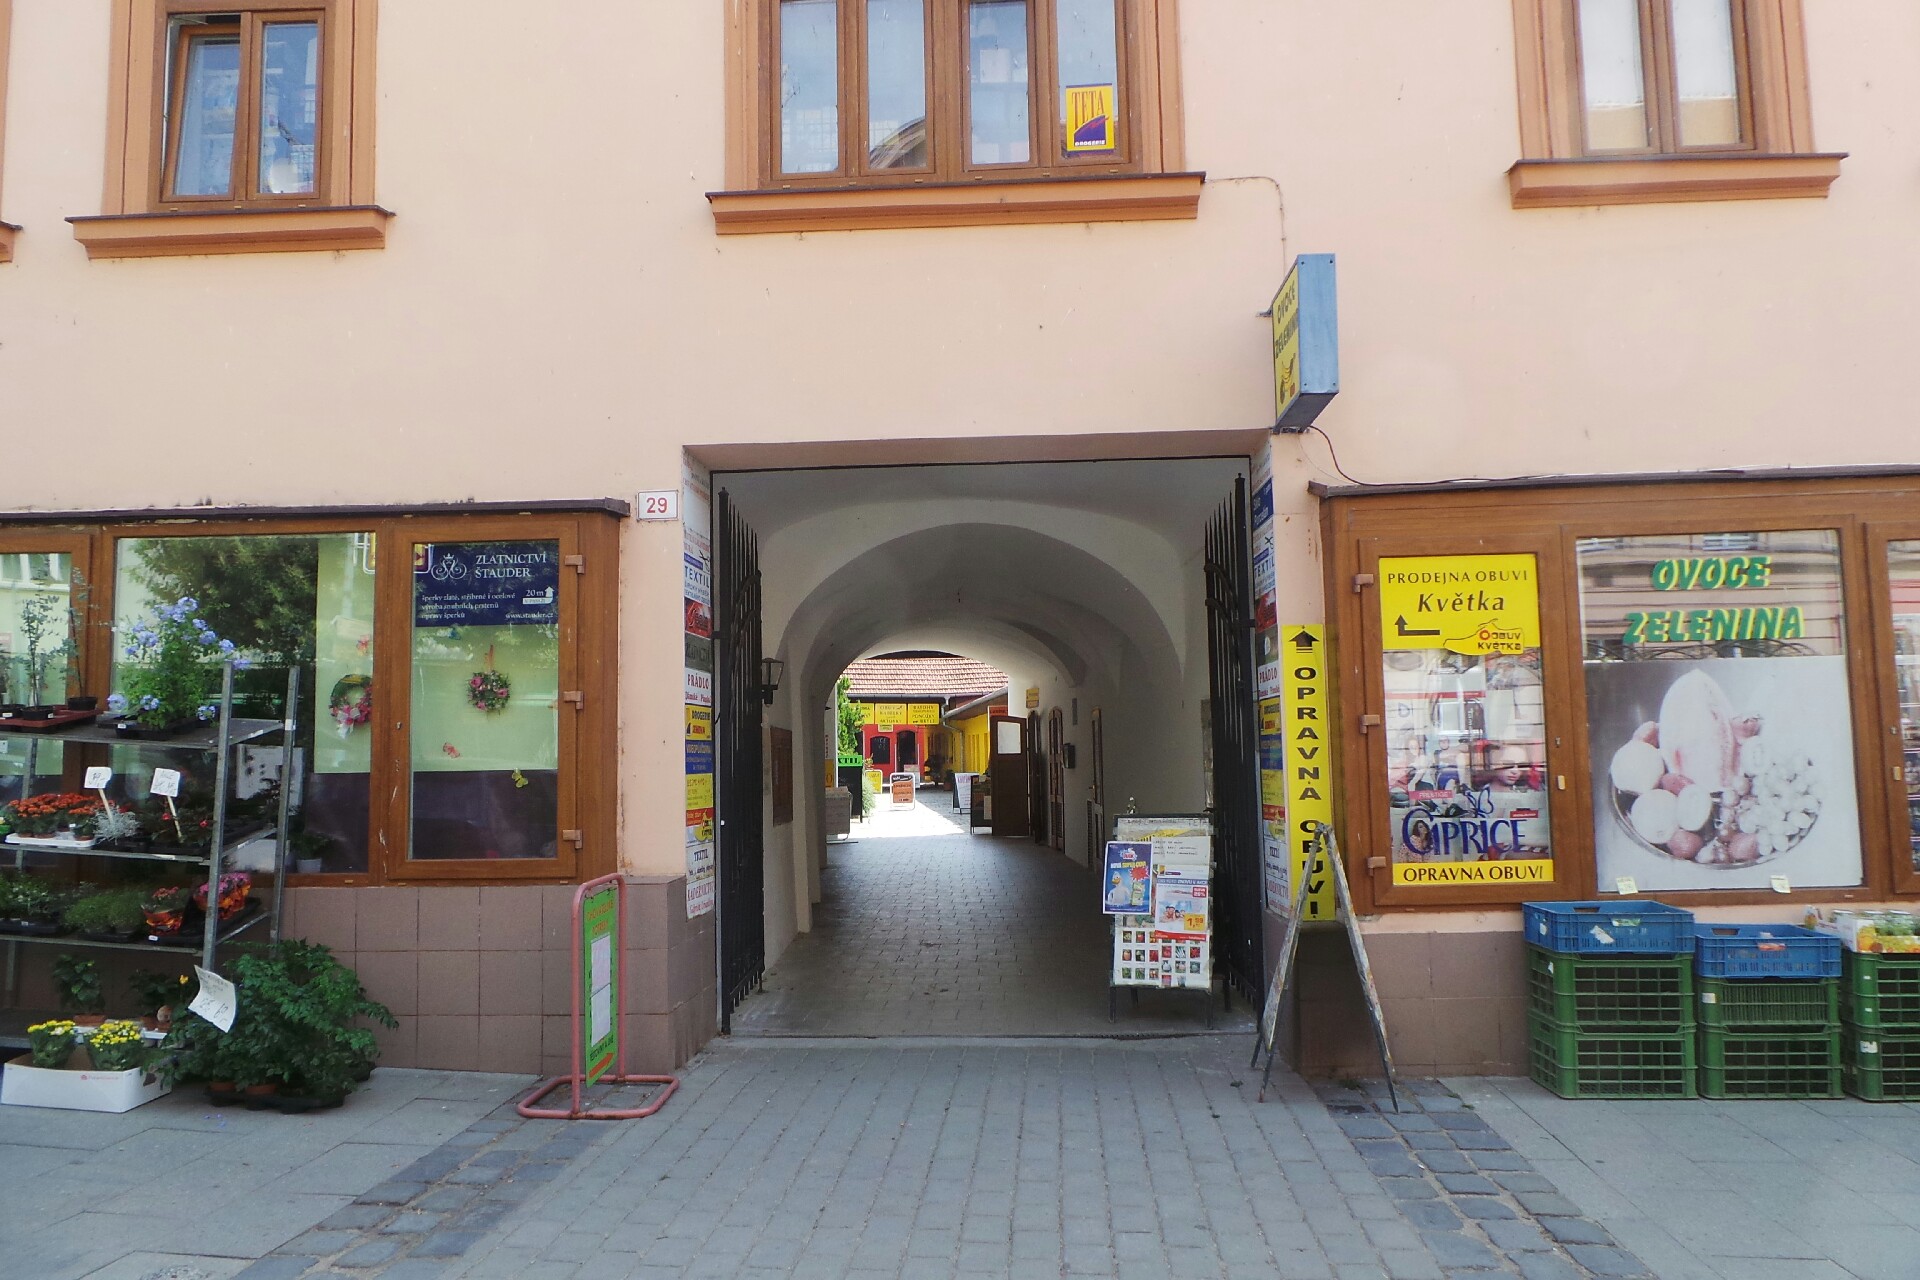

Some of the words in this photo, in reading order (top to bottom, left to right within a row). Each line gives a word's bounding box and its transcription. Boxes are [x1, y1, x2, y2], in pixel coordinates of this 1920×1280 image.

[1277, 280, 1295, 324] OVOCE
[647, 497, 668, 514] 29
[475, 552, 547, 565] ZLATNICTVÍ
[475, 567, 530, 579] ŠTAUDER
[684, 565, 710, 588] TEXTIL
[1388, 572, 1471, 584] PRODEJNA
[1475, 570, 1527, 582] OBUVI
[1652, 556, 1772, 591] OVOCE
[1417, 590, 1505, 612] Květka
[505, 611, 554, 619] www.stauder.cz
[1622, 606, 1804, 644] ZELENINA
[687, 673, 710, 690] PRÁDLO
[1294, 667, 1321, 800] OPRAVNA
[1403, 867, 1485, 882] OPRAVNA
[1489, 865, 1543, 880] OBUVI
